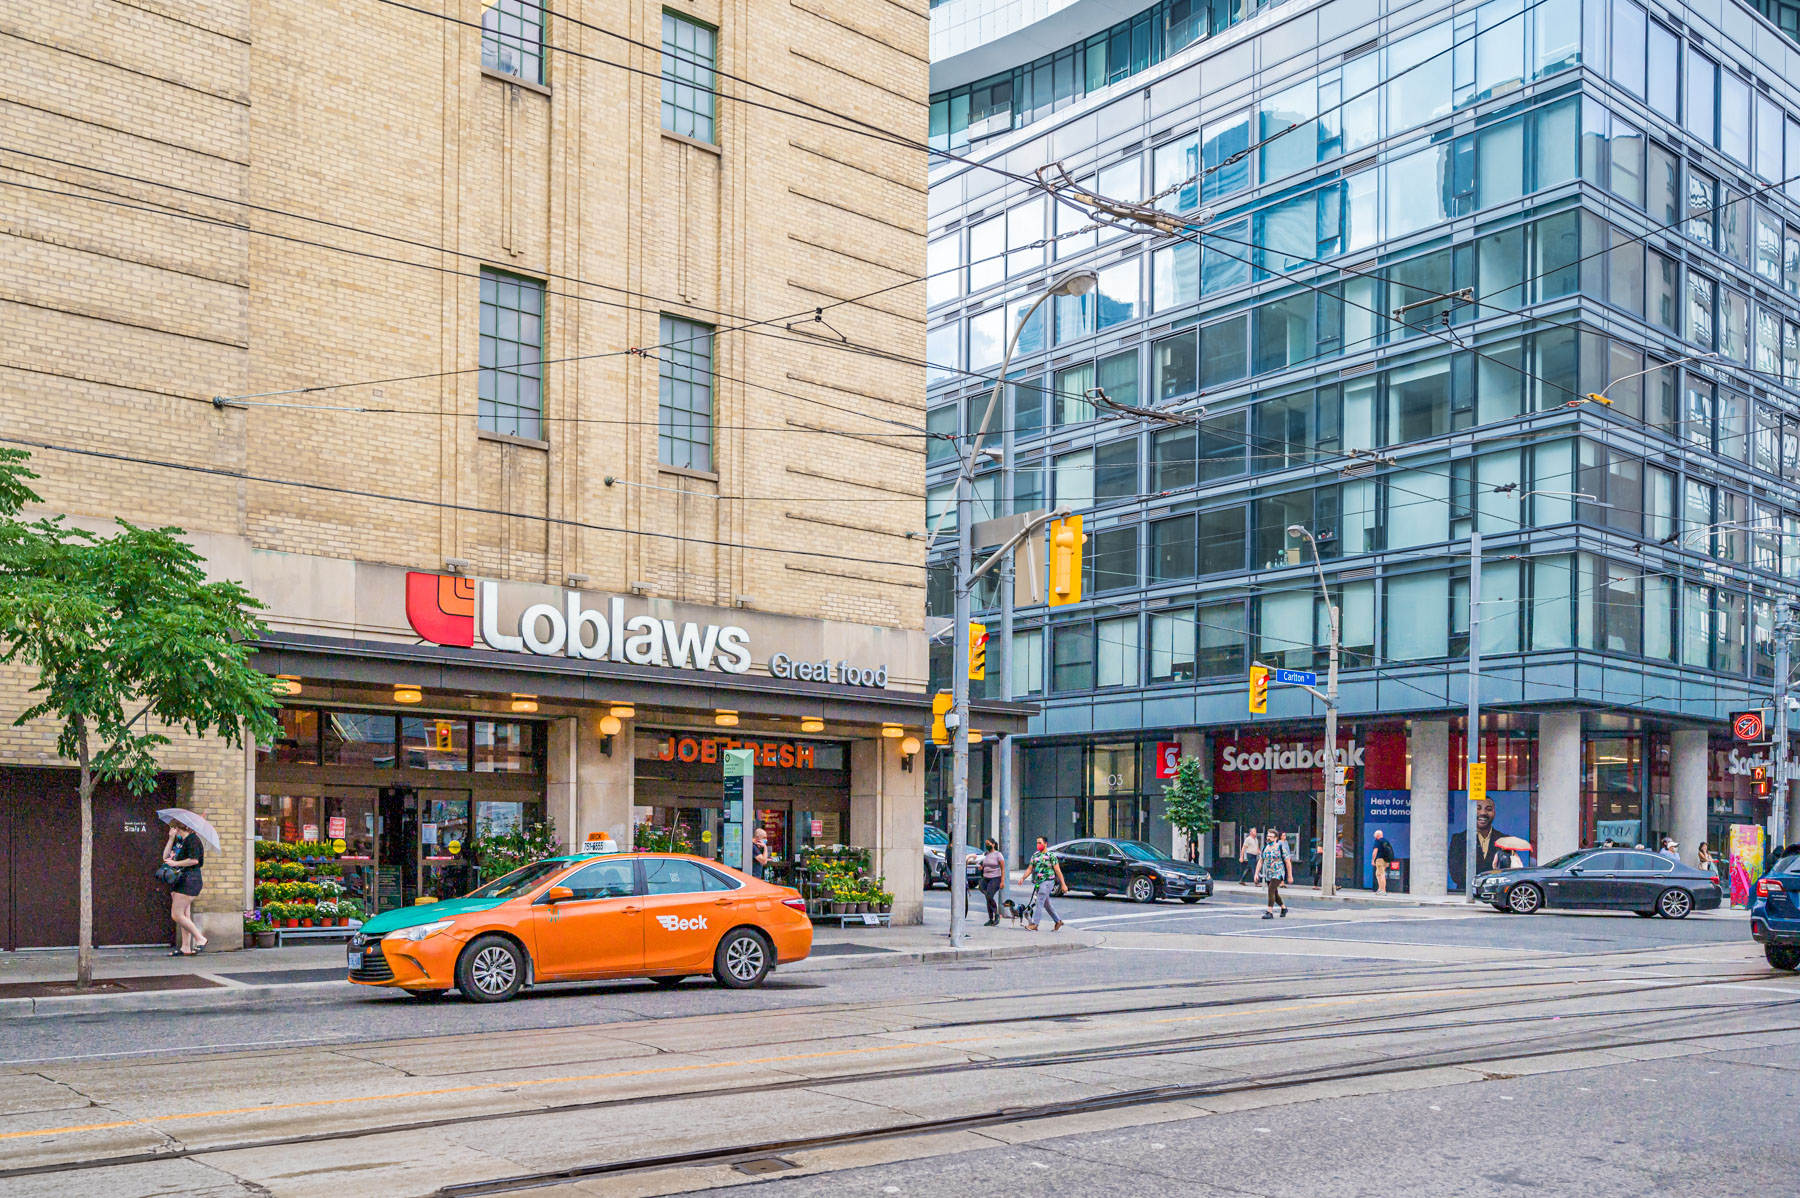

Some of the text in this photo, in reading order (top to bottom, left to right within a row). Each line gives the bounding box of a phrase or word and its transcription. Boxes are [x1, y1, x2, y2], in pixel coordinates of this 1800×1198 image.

[480, 581, 752, 674] Loblaws
[769, 653, 888, 688] Great food
[1284, 671, 1305, 683] Carlton
[659, 737, 717, 764] JOE
[1370, 797, 1391, 805] Here
[1392, 797, 1404, 805] for
[1370, 807, 1388, 816] and
[141, 825, 147, 833] A
[662, 914, 709, 931] Beck
